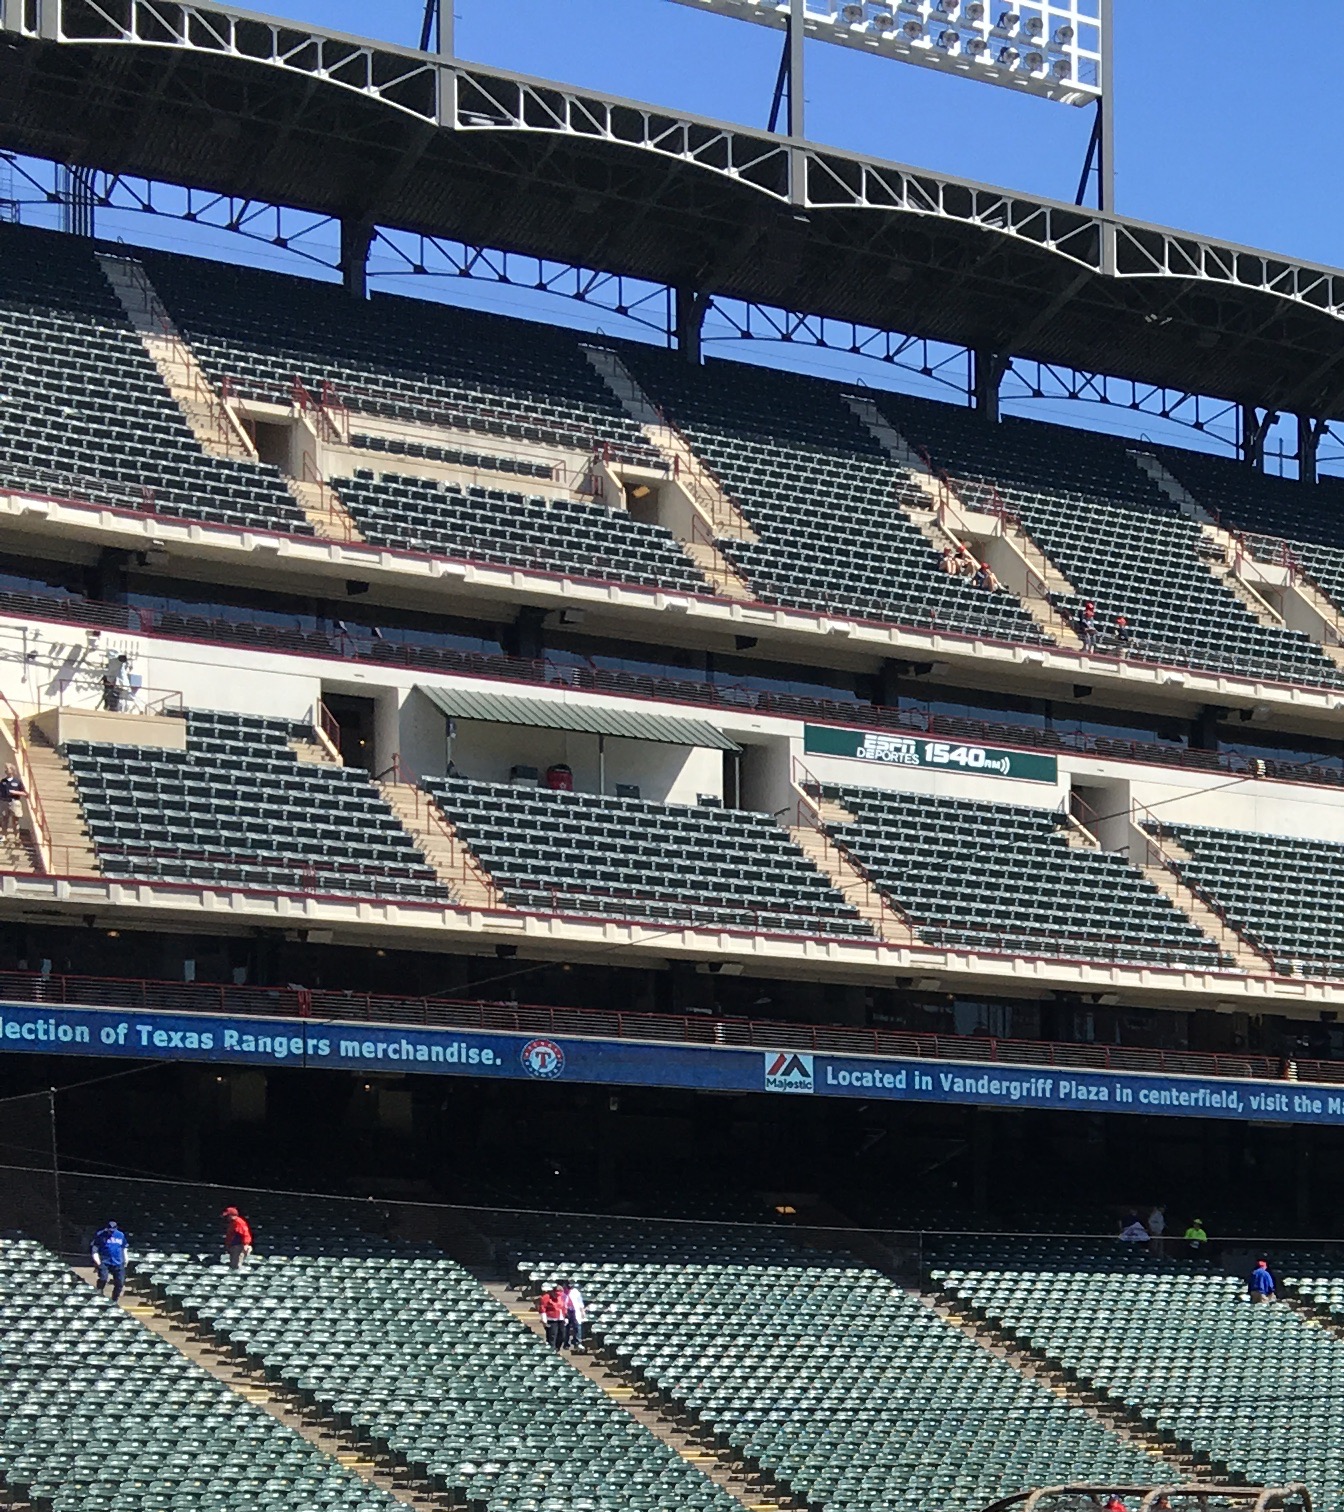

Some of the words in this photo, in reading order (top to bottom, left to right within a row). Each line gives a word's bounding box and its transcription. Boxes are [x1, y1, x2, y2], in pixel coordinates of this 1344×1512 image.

[856, 747, 920, 766] DEPORTES
[863, 734, 917, 755] ESPN
[924, 742, 987, 768] 1540
[100, 1023, 129, 1047] of
[135, 1025, 214, 1050] Texas
[224, 1030, 331, 1059] Rangers
[339, 1039, 502, 1066] merchandise.
[826, 1066, 908, 1090] Located
[914, 1072, 933, 1090] in
[940, 1073, 1053, 1102] Vandergriff
[1059, 1082, 1110, 1102] Plaza
[1115, 1083, 1134, 1104] in
[1138, 1086, 1243, 1113] centerfield,
[1249, 1091, 1289, 1113] visit
[1294, 1095, 1322, 1115] the
